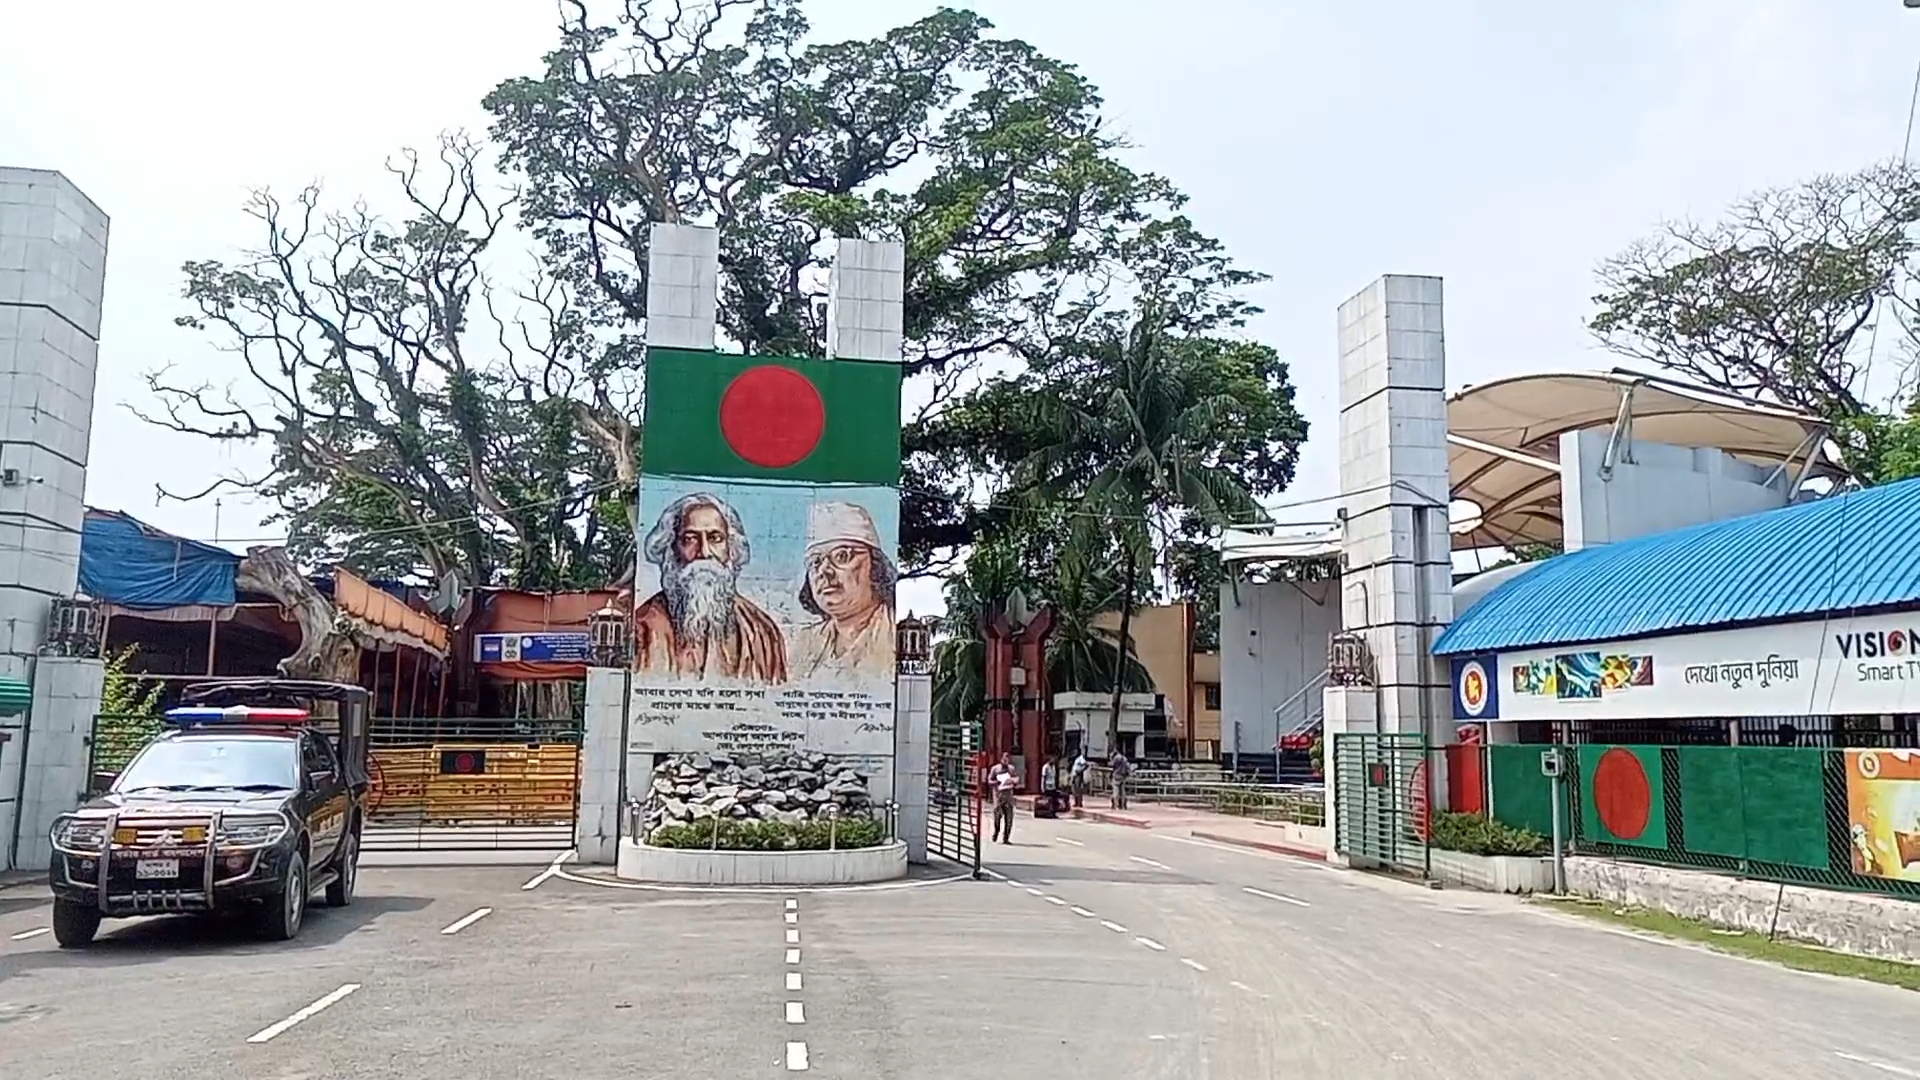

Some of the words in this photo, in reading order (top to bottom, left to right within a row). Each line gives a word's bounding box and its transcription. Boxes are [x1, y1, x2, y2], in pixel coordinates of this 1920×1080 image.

[1836, 628, 1920, 658] VISION
[1684, 665, 1718, 684] দেখো
[1720, 661, 1753, 689] নতুন
[1756, 654, 1799, 688] দুনিয়া
[1857, 662, 1904, 681] Smart
[1905, 660, 1920, 679] T
